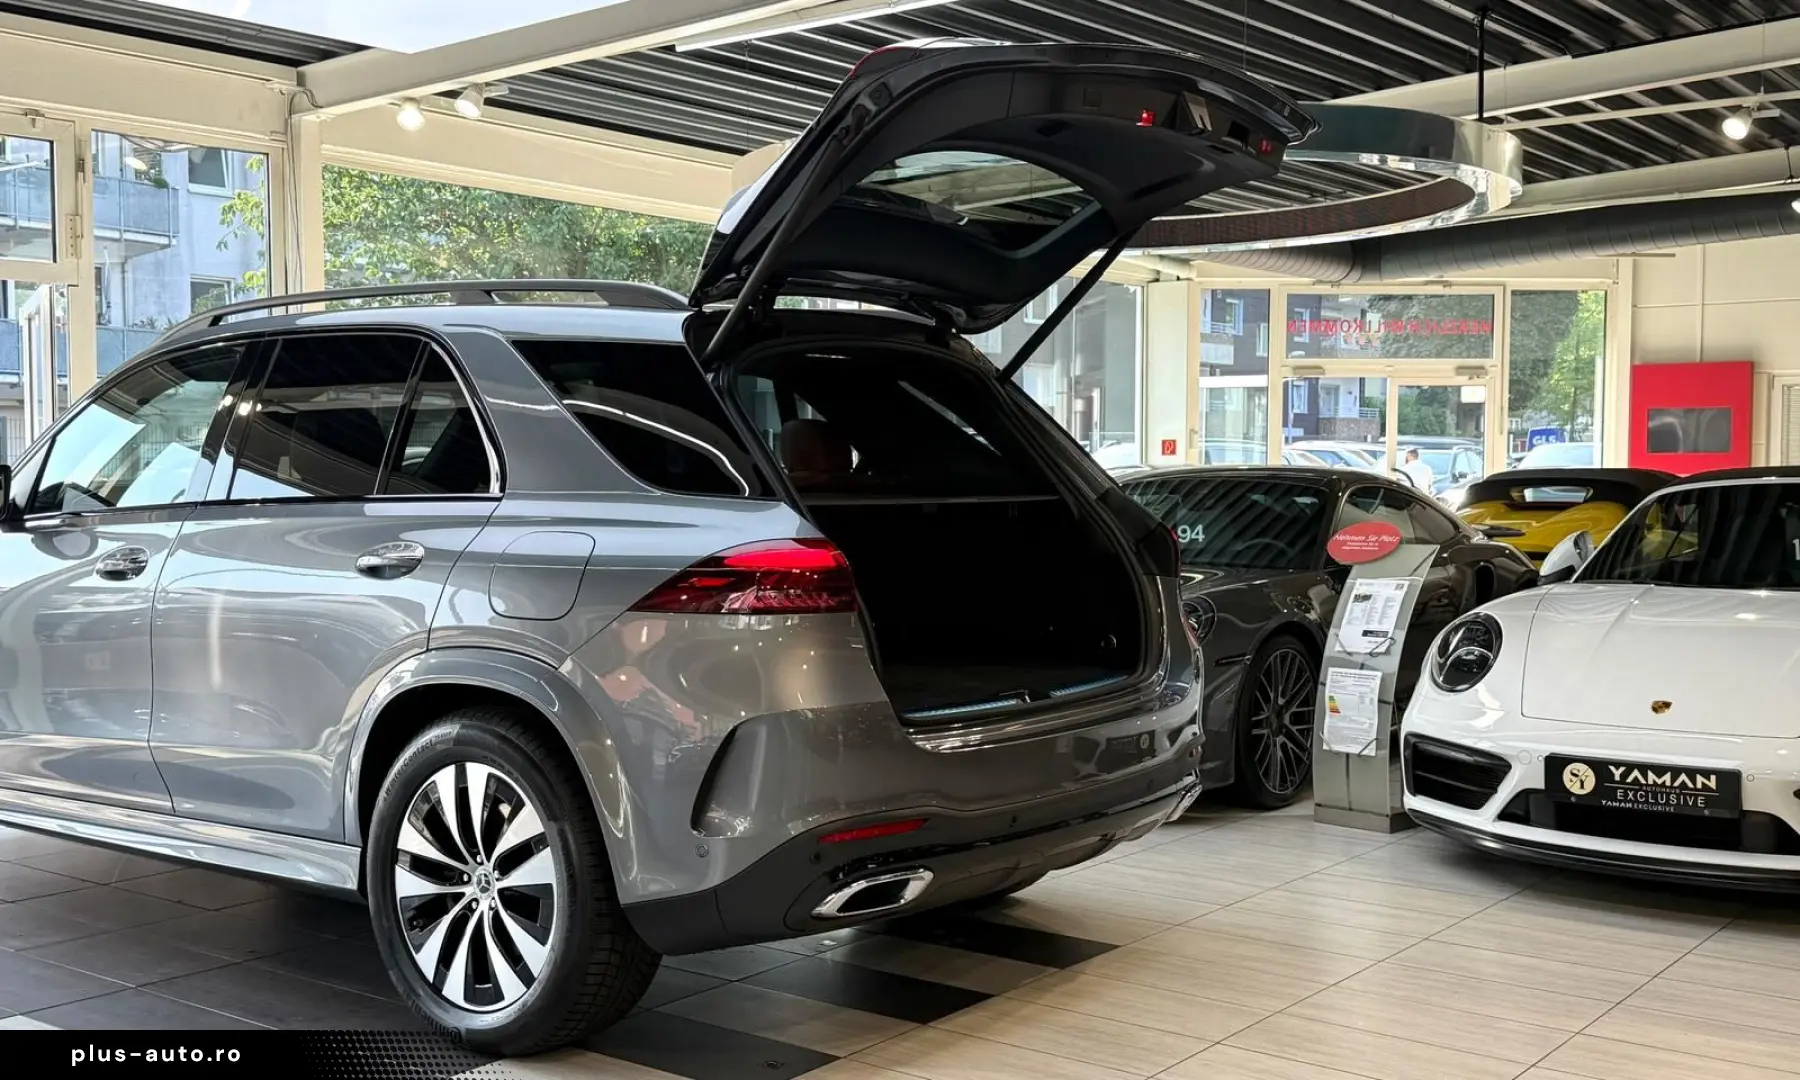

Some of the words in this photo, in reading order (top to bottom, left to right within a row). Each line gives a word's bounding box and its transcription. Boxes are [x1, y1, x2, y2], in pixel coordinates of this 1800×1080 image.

[1608, 765, 1717, 790] YAMAN
[1642, 785, 1680, 794] AUTOHAUS
[1601, 799, 1633, 808] YAMAN
[1633, 802, 1675, 812] EXCLUSIVE
[1616, 789, 1707, 808] EXCLUSIVE
